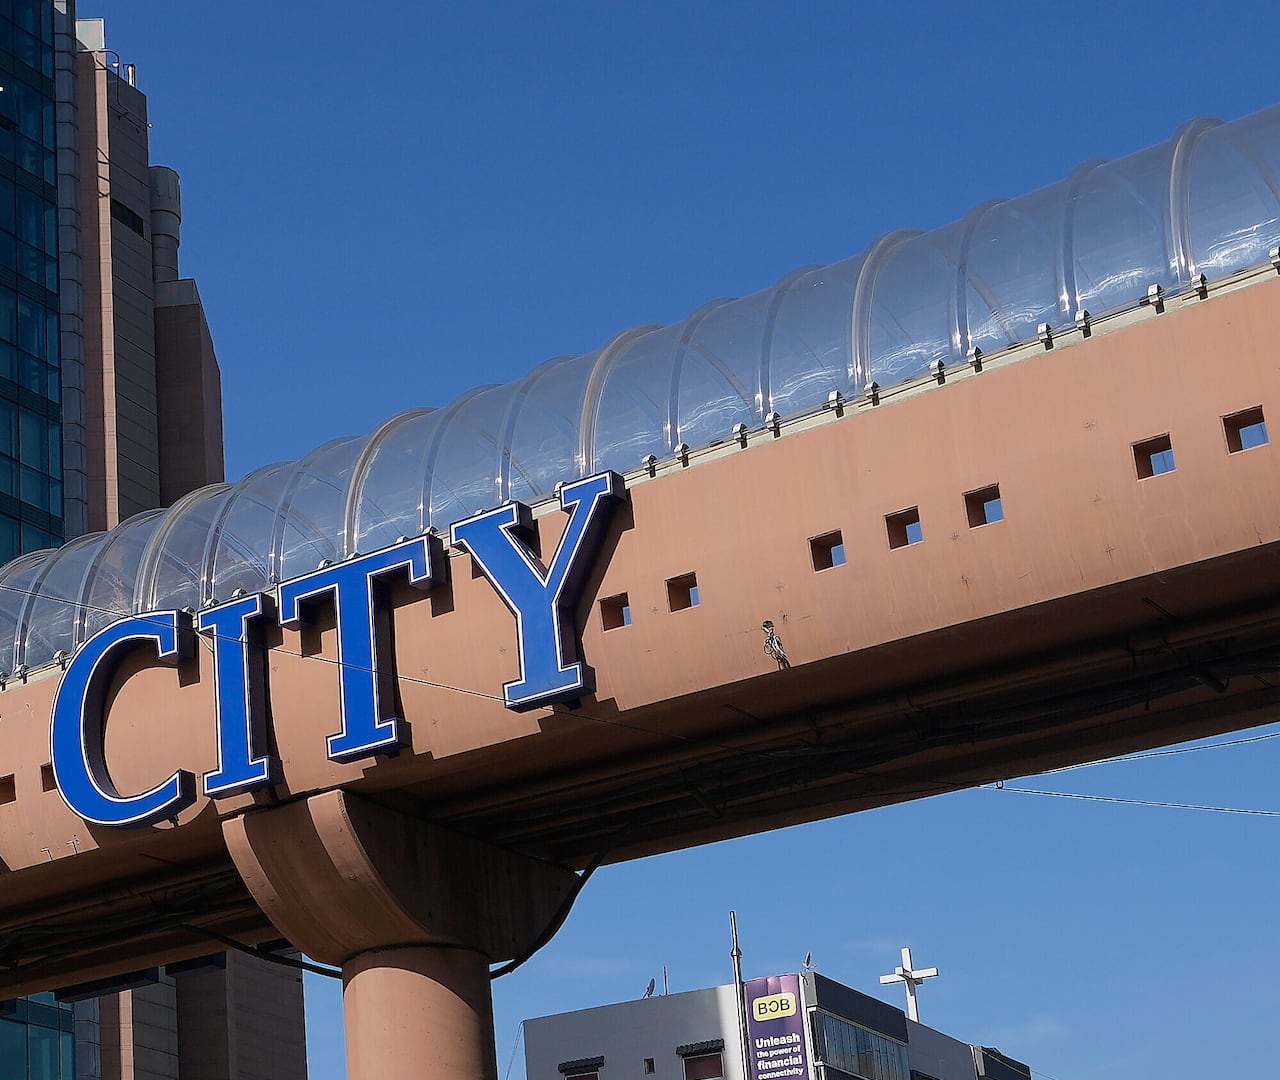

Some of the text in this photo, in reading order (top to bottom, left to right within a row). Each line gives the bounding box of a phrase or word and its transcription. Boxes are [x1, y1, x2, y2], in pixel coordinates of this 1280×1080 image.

[50, 470, 625, 828] CITY
[755, 1033, 801, 1048] Unleash
[770, 1048, 792, 1057] power
[793, 1045, 801, 1053] of
[757, 1055, 802, 1070] financial
[758, 1067, 804, 1080] connectivity
